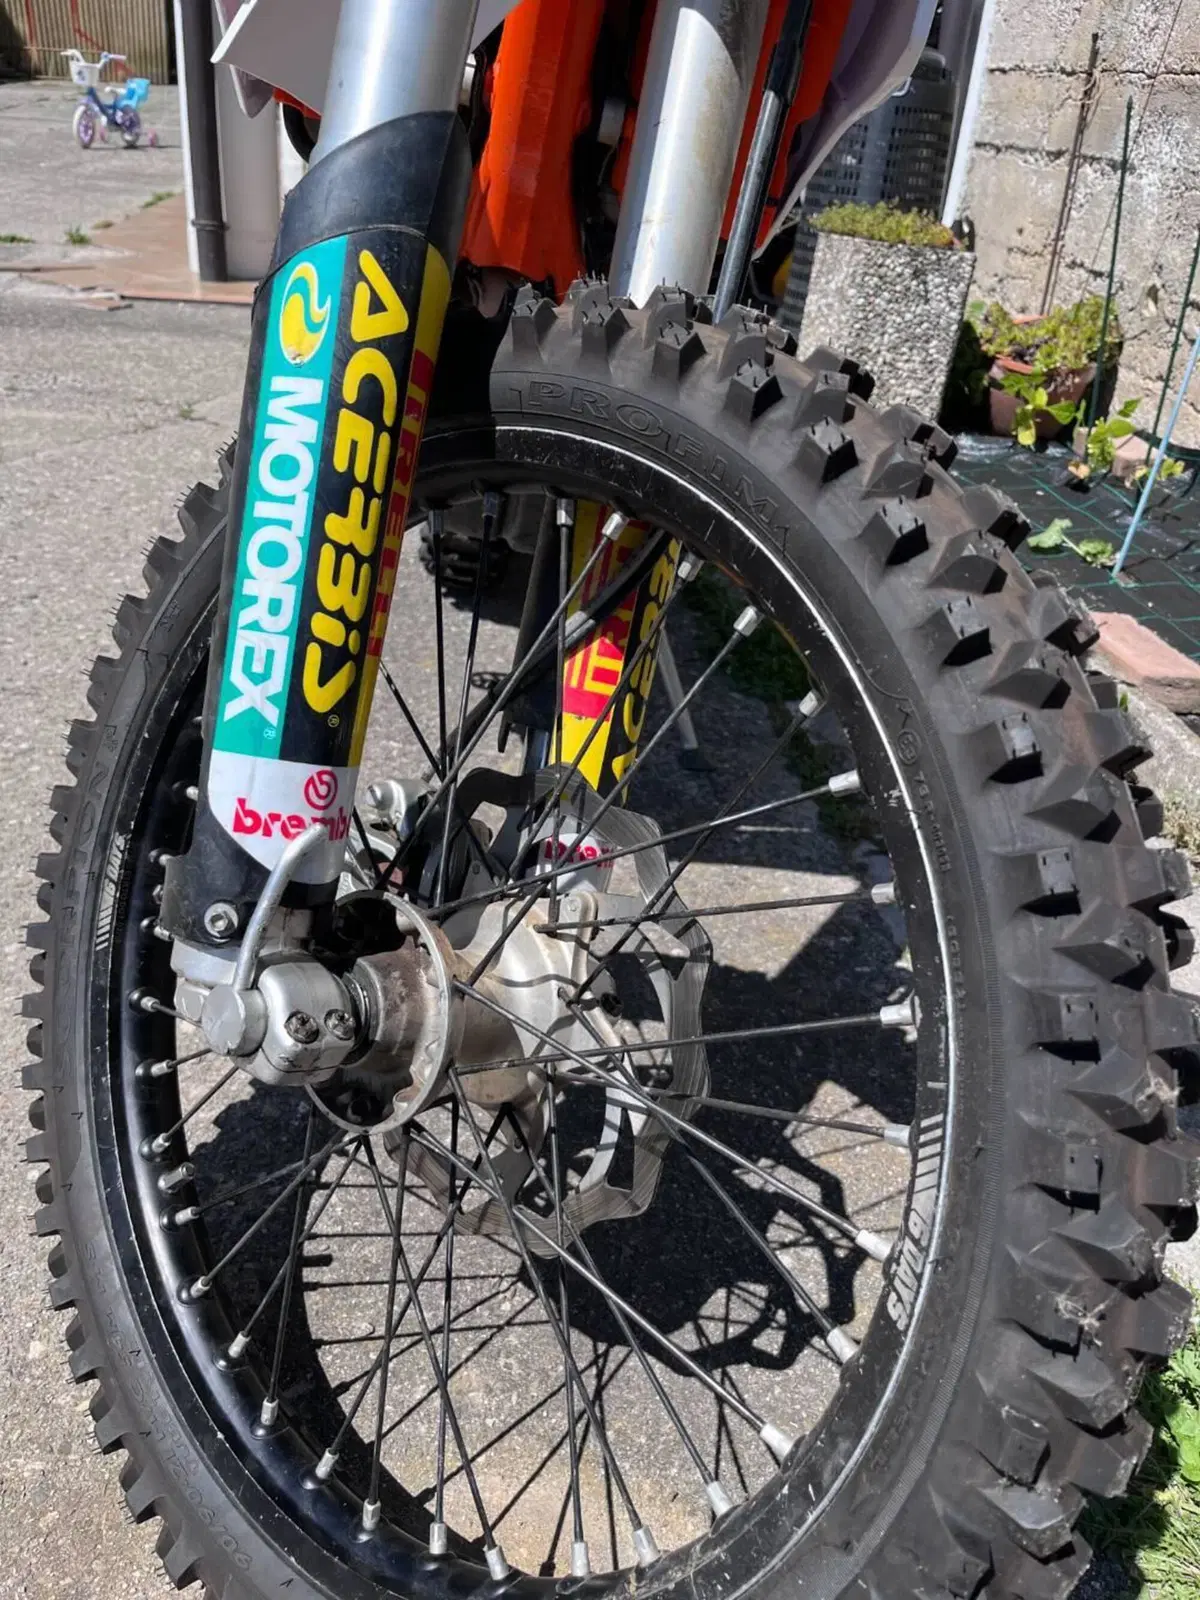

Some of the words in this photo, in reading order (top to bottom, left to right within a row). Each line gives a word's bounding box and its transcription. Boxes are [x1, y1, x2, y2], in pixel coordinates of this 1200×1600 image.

[223, 375, 324, 728] MOTOREX
[303, 249, 409, 713] ACERBIS
[232, 797, 351, 842] bremb
